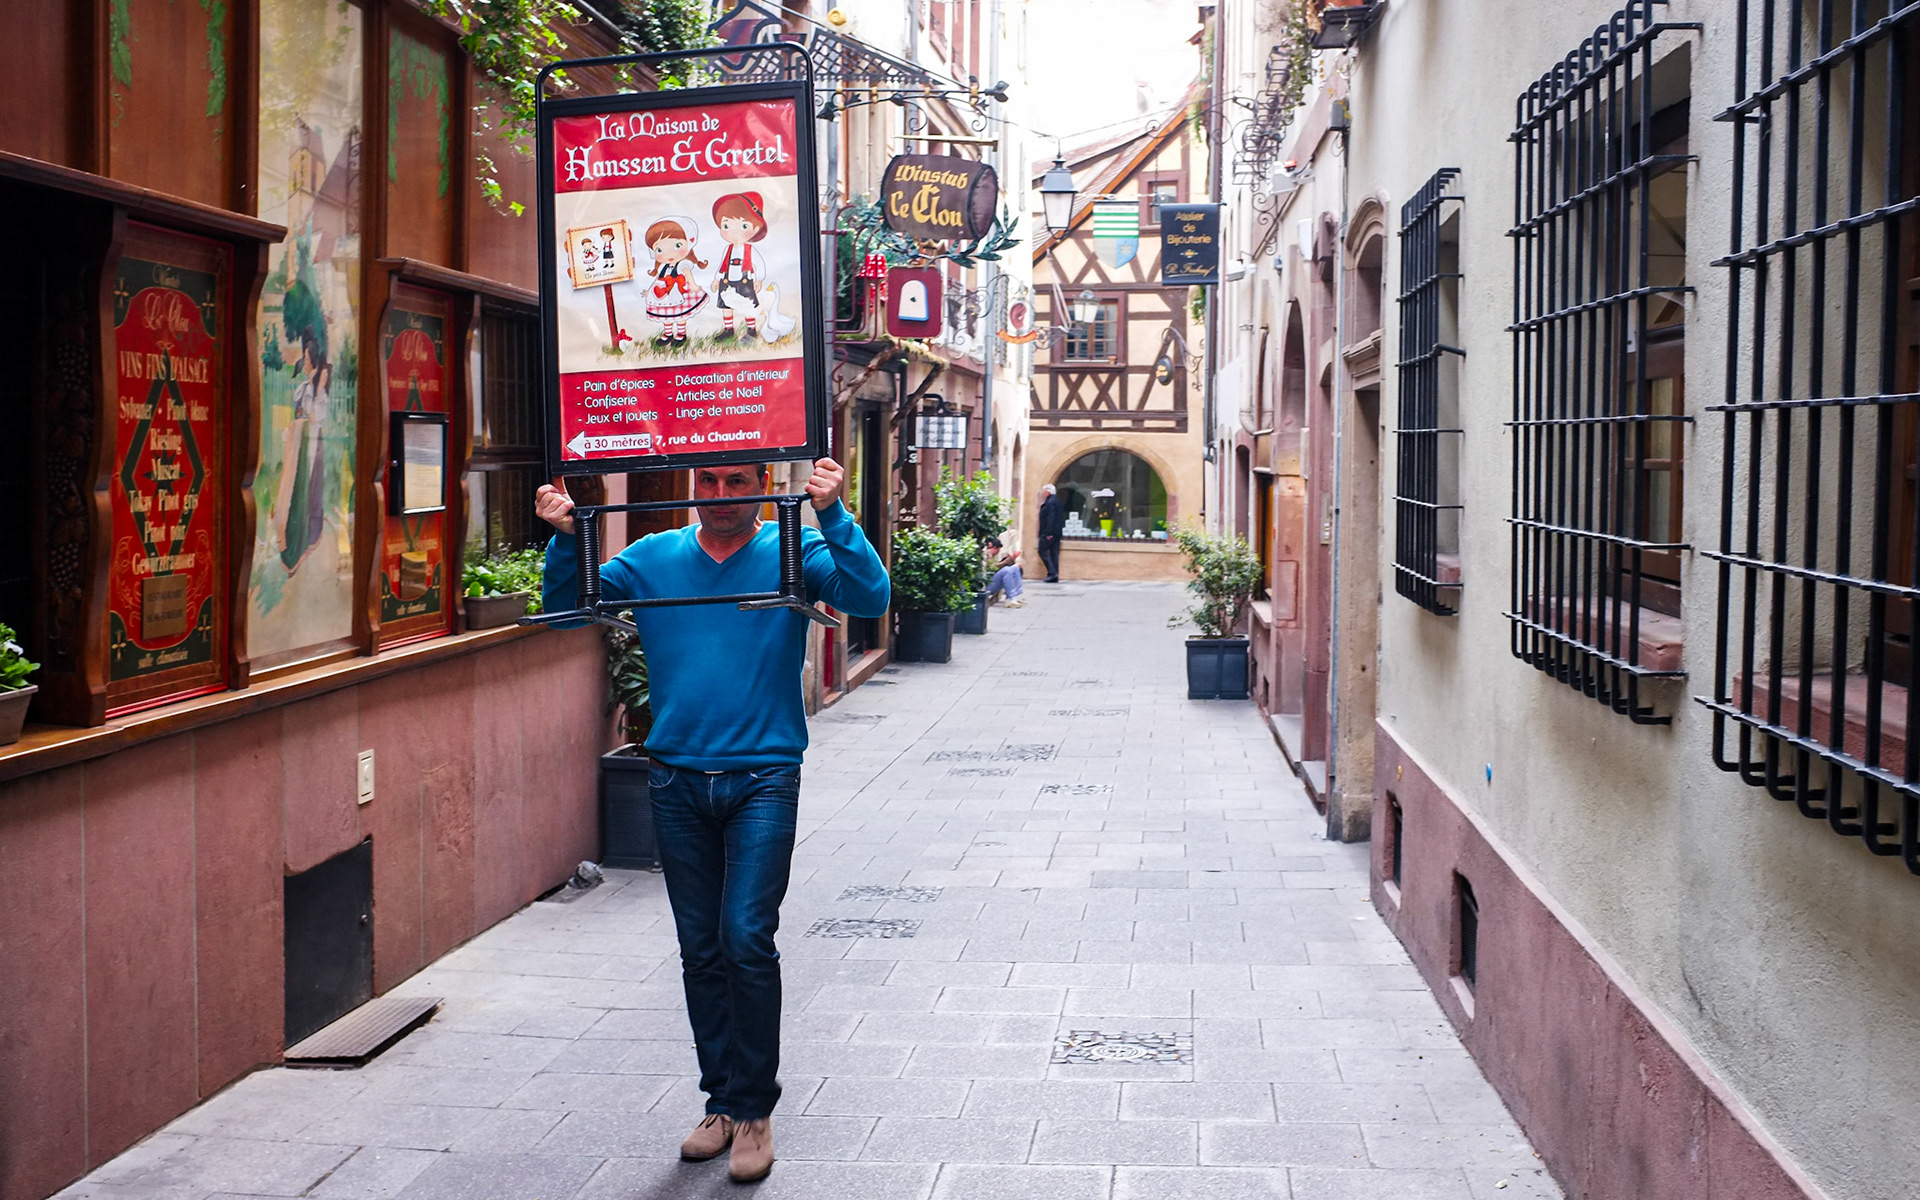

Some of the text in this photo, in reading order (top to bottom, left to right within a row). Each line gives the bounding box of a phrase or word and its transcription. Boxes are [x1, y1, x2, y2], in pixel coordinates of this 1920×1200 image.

[595, 112, 720, 143] La Maison de
[564, 132, 789, 182] Hanssen & Gretel
[894, 164, 969, 190] Winstub
[911, 183, 964, 227] Clou
[1174, 211, 1206, 222] Atelier
[1182, 223, 1197, 233] de
[1166, 234, 1213, 247] Bijouterie
[120, 350, 209, 384] VINS FINS D'ALSACE
[583, 377, 655, 392] Pain d'épices
[674, 369, 790, 387] Décoration d'intérieur
[584, 395, 638, 409] Confiserie
[675, 385, 763, 403] Articles de Noël
[585, 409, 658, 425] Jeux et jouets
[675, 402, 765, 420] Linge de maison
[583, 435, 650, 450] à 30 mètres
[655, 429, 761, 447] 7, rue du Chaudron
[151, 457, 180, 481] Muscat
[158, 488, 180, 512] Pinot
[144, 520, 166, 544] Pinot
